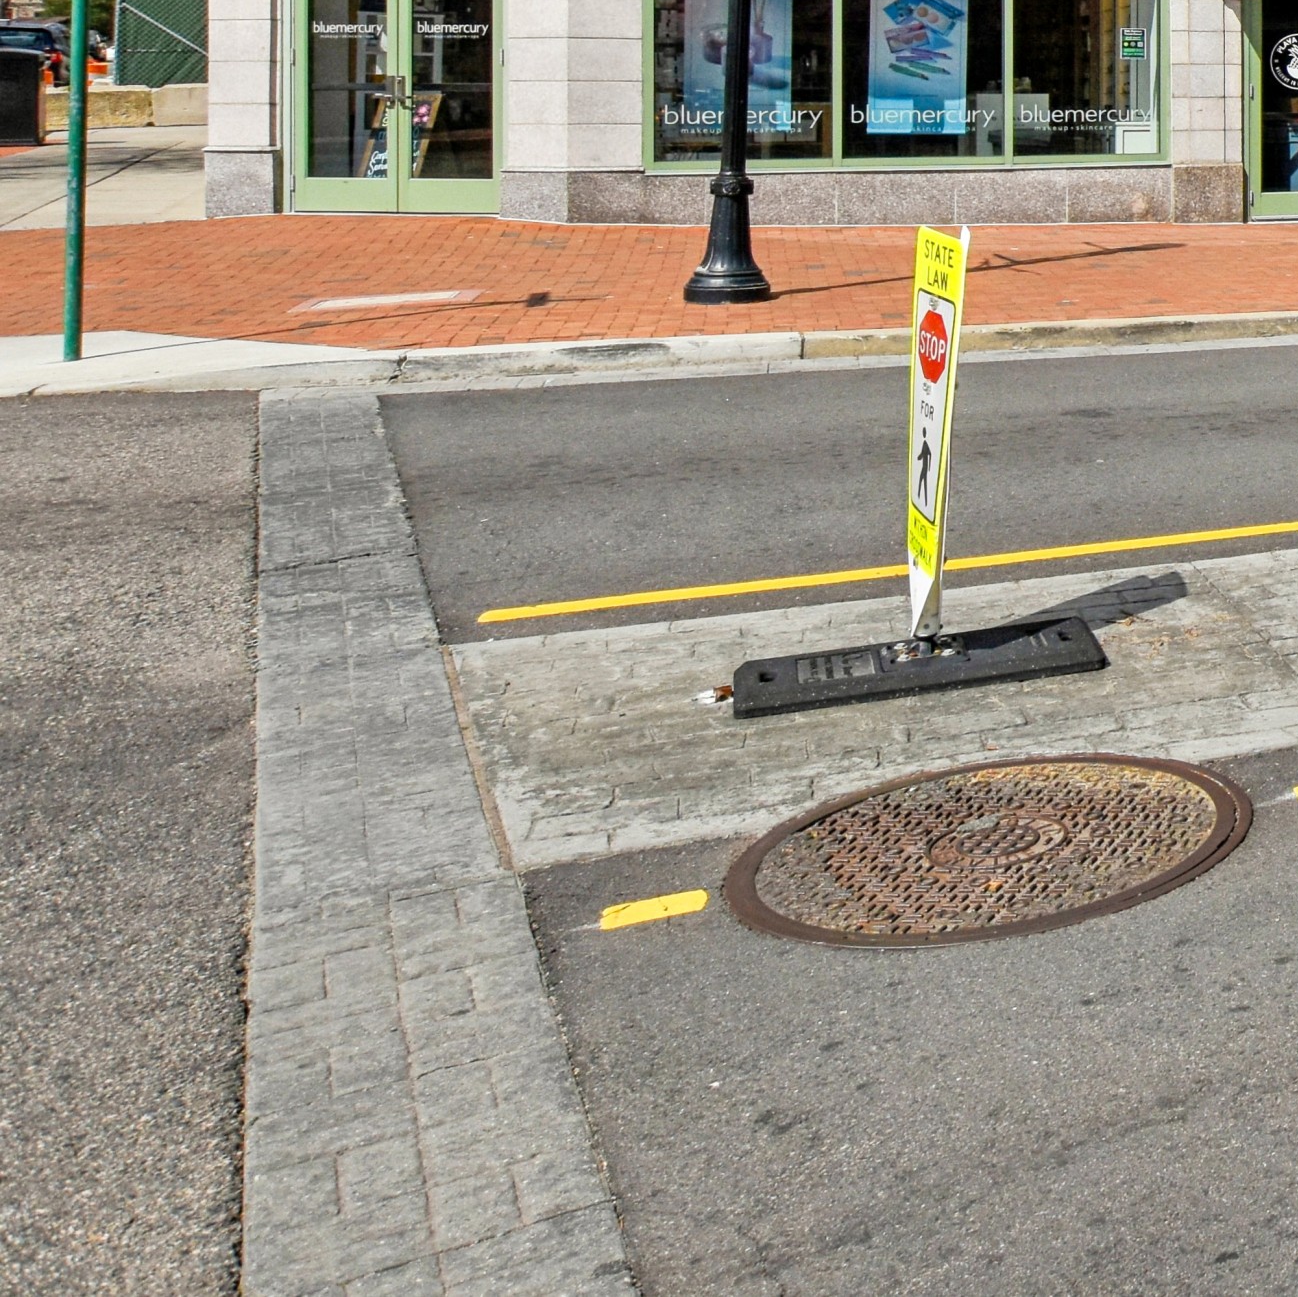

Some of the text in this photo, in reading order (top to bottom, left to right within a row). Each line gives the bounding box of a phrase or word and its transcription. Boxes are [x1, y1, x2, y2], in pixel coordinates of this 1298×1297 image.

[313, 20, 384, 36] bluemercury
[417, 20, 489, 36] bluemercury
[1276, 37, 1298, 54] PLAYA
[850, 104, 996, 128] bluemercury
[1020, 104, 1151, 126] bluemercury
[1034, 125, 1069, 133] makeup
[924, 239, 955, 269] STATE
[927, 266, 949, 292] LAW
[919, 330, 947, 363] STOP
[920, 399, 935, 422] FOR
